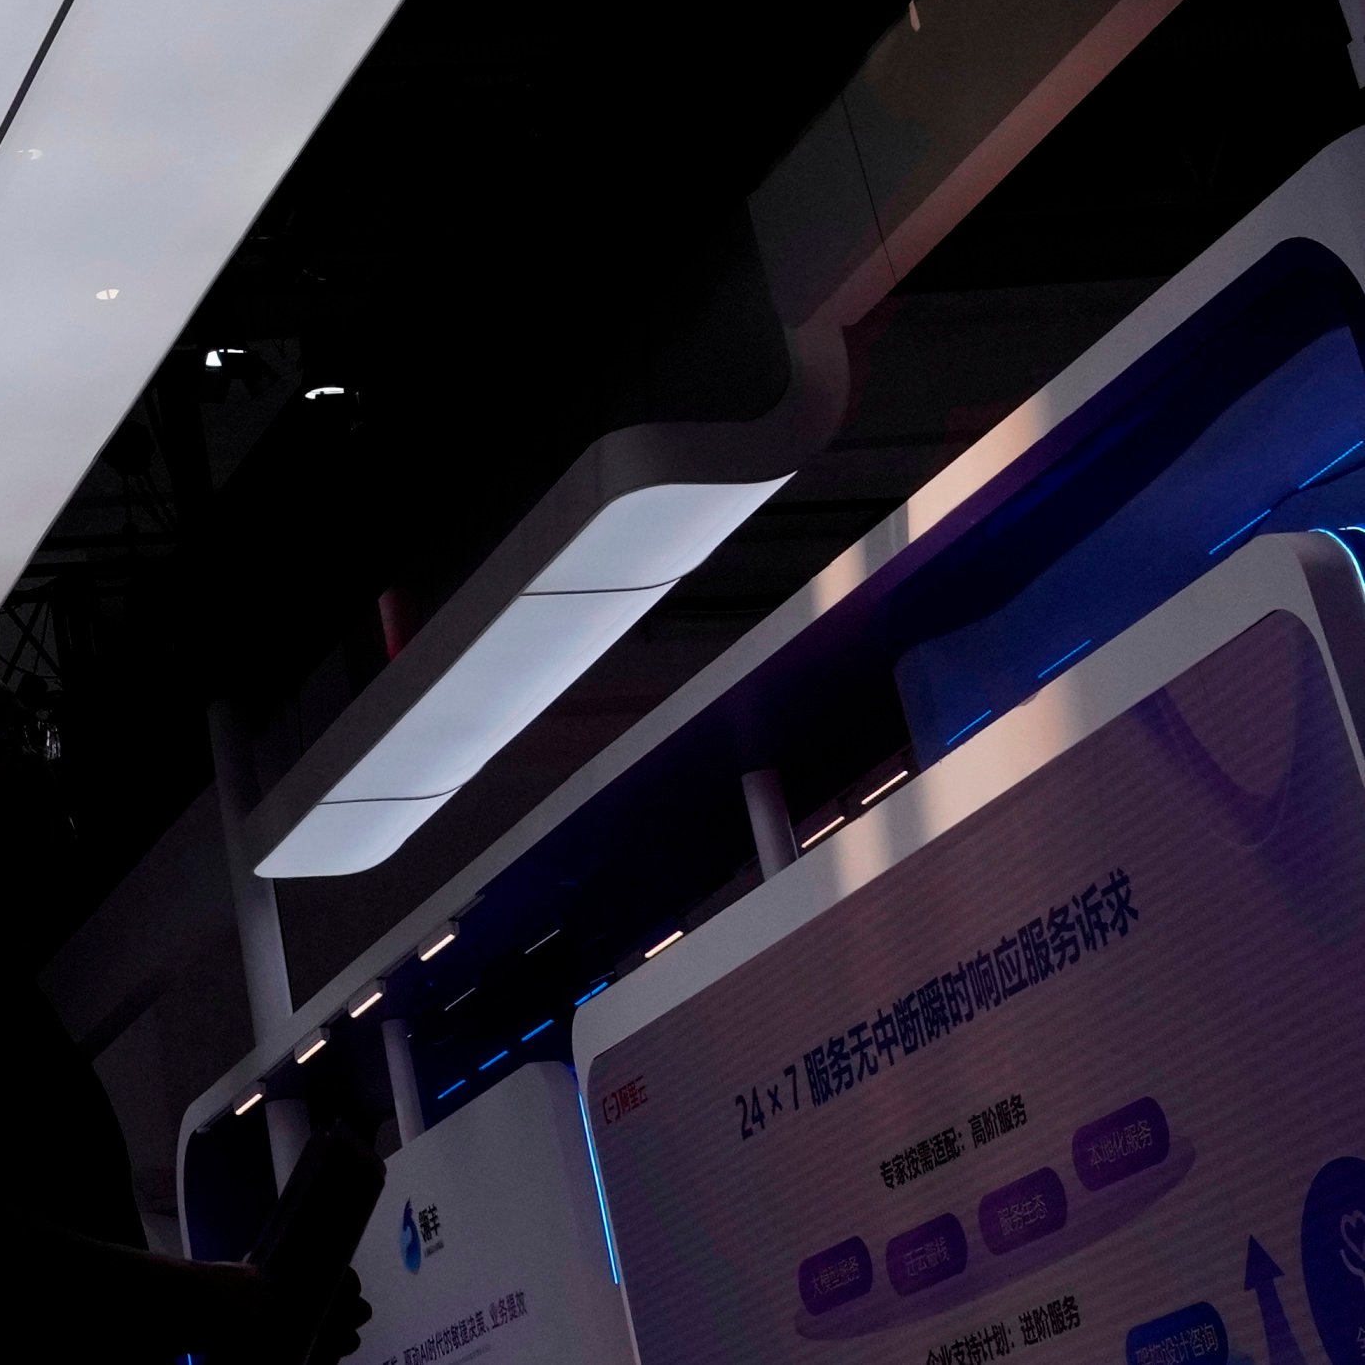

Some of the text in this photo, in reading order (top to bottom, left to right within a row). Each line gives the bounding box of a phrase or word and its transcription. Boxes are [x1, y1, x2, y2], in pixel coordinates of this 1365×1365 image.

[735, 1085, 765, 1140] 24
[783, 1065, 801, 1112] 7
[803, 868, 1140, 1107] 服务无中断瞬时响应服务诉求
